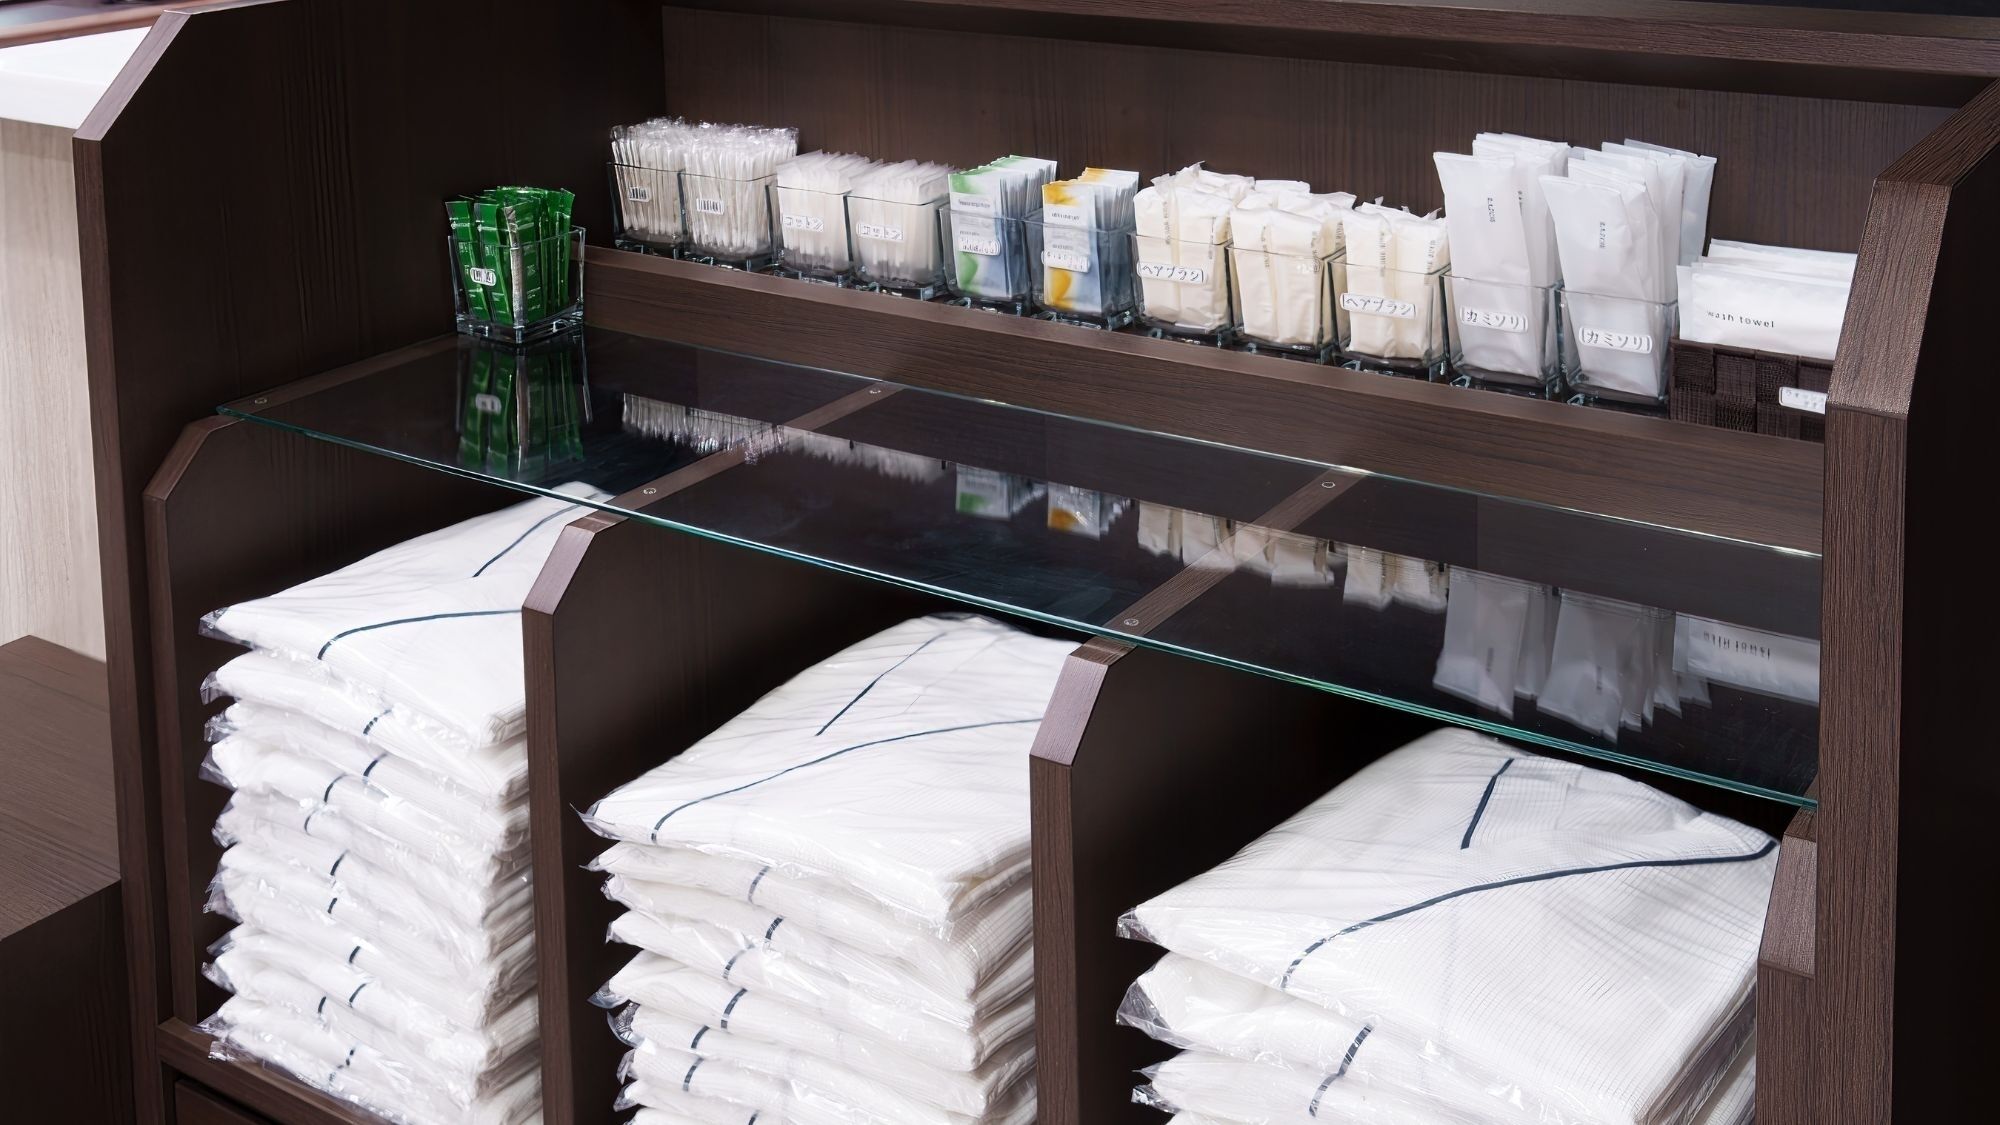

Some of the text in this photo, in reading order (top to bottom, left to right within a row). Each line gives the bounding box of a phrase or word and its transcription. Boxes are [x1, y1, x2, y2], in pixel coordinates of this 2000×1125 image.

[1466, 308, 1520, 329] カミソリ
[1739, 316, 1774, 328] towel
[1587, 331, 1643, 350] カミソリ
